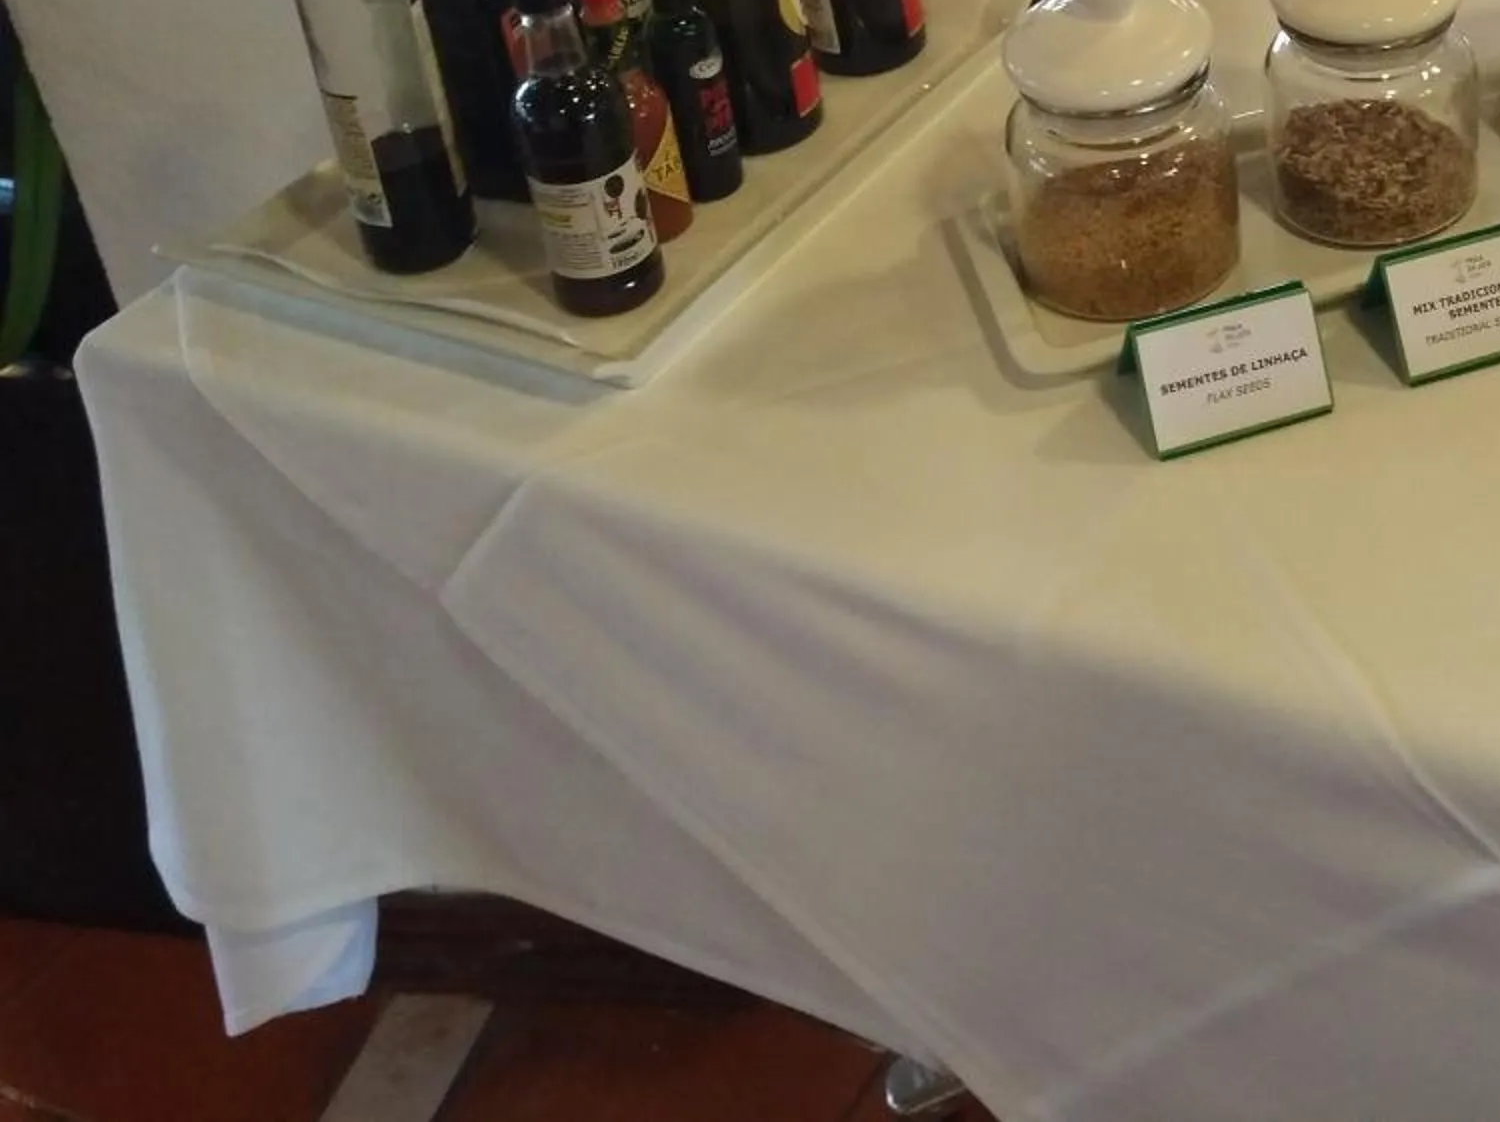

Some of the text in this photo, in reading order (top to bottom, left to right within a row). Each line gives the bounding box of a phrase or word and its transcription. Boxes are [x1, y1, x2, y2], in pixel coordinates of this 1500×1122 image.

[1412, 300, 1437, 316] MIX
[1160, 347, 1309, 396] SEMENTES DE LINHAÇA
[1206, 377, 1271, 405] FLAX SEEDS
